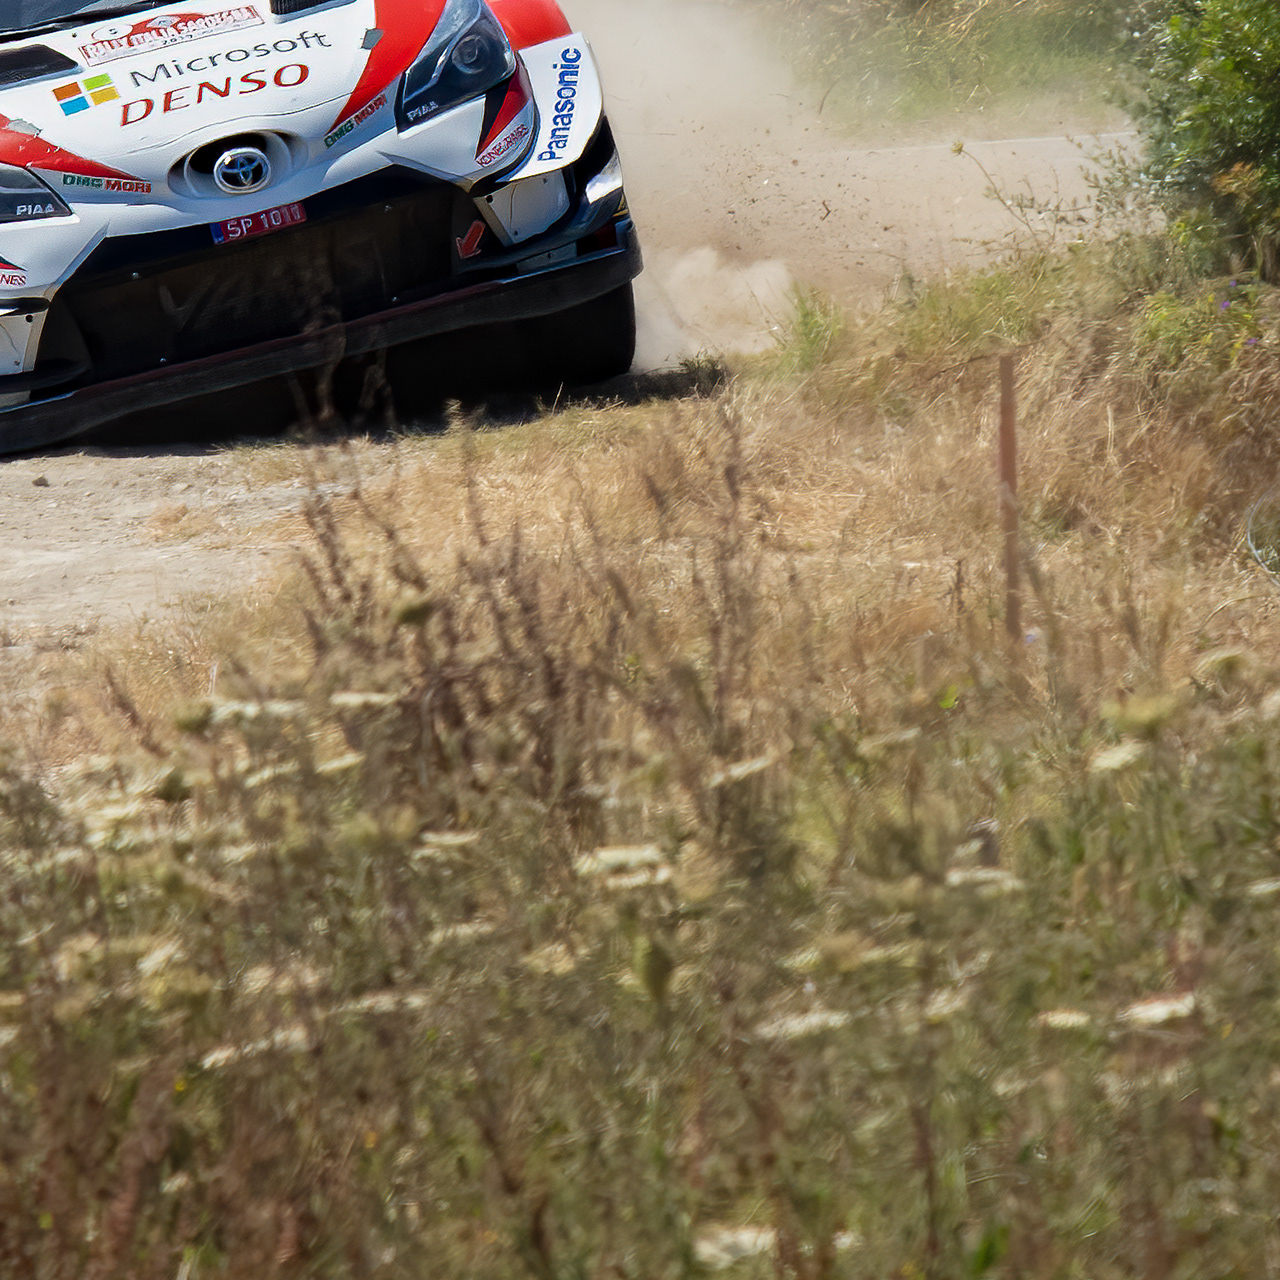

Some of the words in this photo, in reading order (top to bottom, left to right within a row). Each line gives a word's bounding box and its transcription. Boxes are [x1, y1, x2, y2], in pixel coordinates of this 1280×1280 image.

[130, 30, 332, 88] Microsoft
[120, 63, 310, 127] DENSO
[537, 47, 582, 162] Panasonic
[62, 173, 103, 188] DMG
[105, 179, 152, 194] MORI
[16, 203, 55, 216] PIAA
[227, 217, 253, 240] SP
